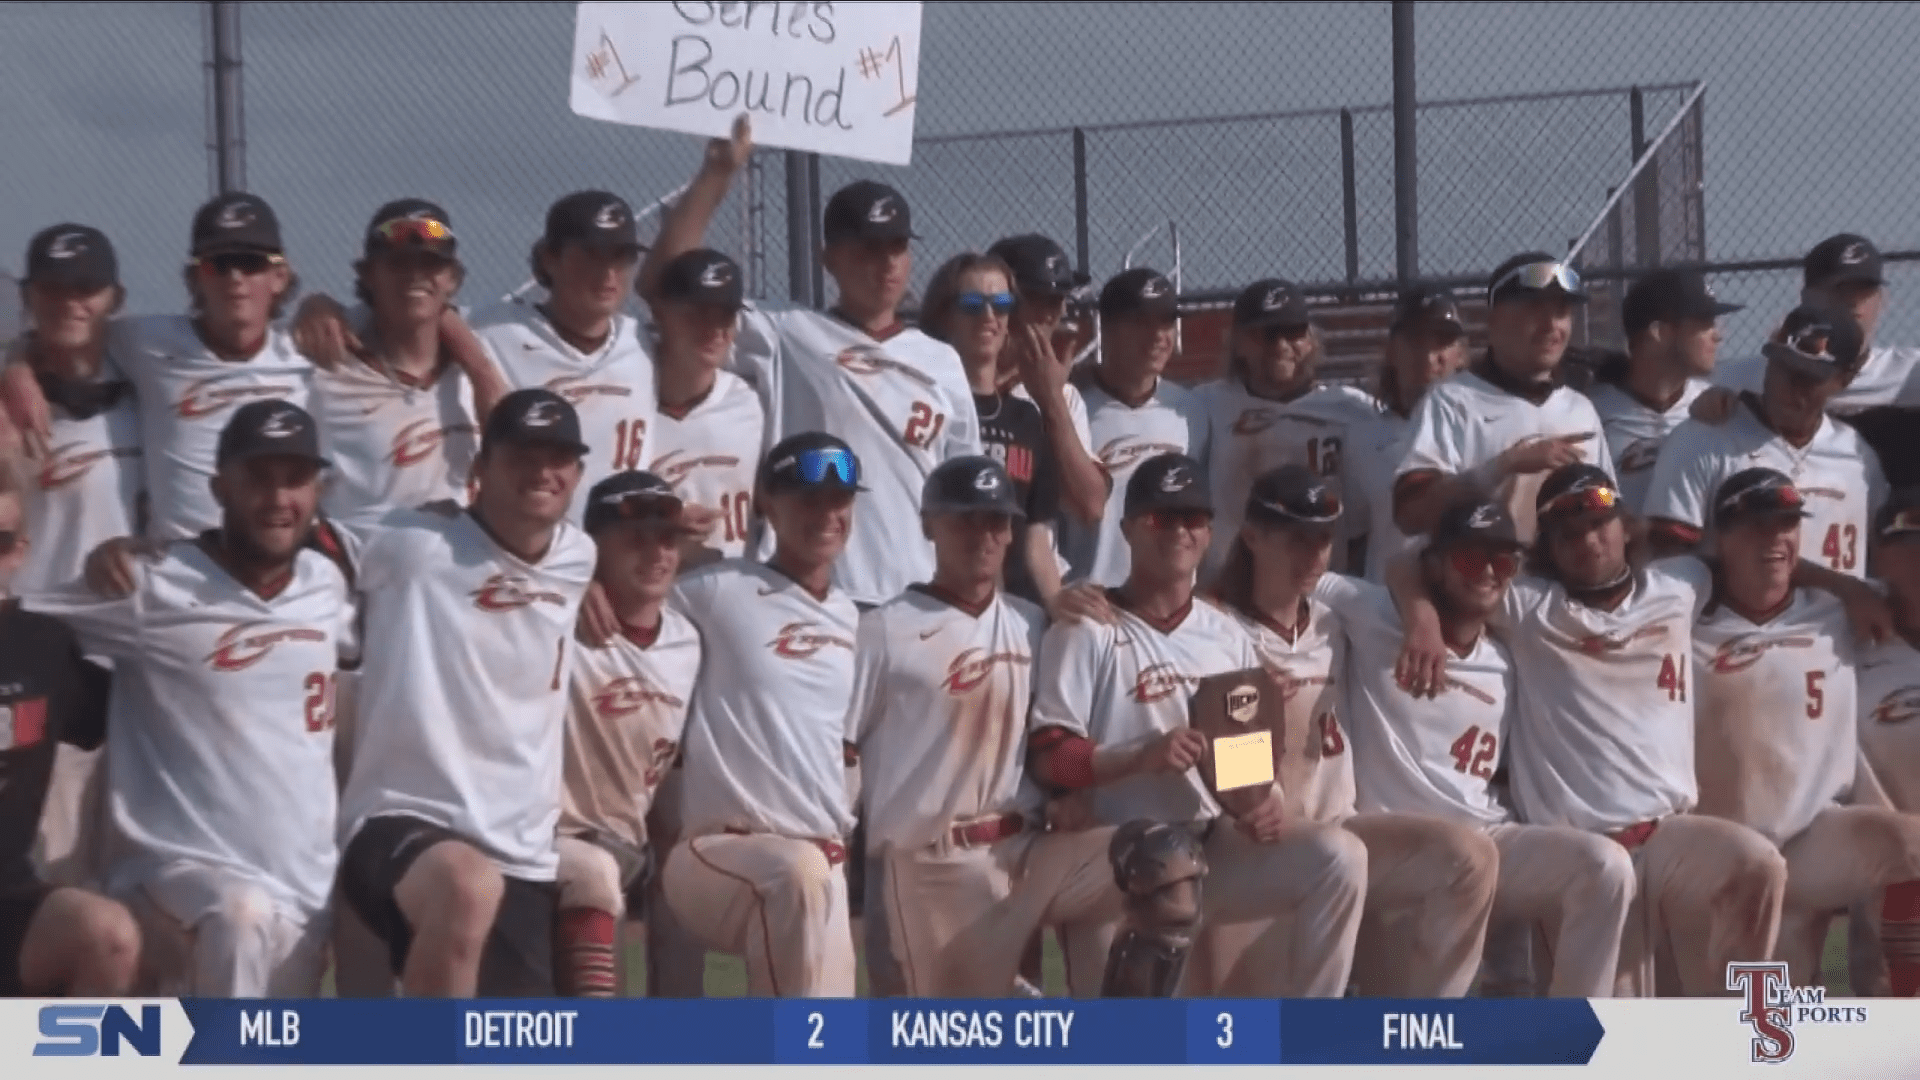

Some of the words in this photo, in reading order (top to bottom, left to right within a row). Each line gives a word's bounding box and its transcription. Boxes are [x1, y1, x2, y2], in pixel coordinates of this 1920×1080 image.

[664, 35, 852, 130] Bound
[855, 35, 917, 118] #1
[612, 418, 646, 471] 16
[904, 400, 945, 451] 21
[721, 491, 750, 542] 10
[1822, 523, 1857, 570] 43
[1805, 671, 1825, 720] 5
[1449, 724, 1497, 781] 42
